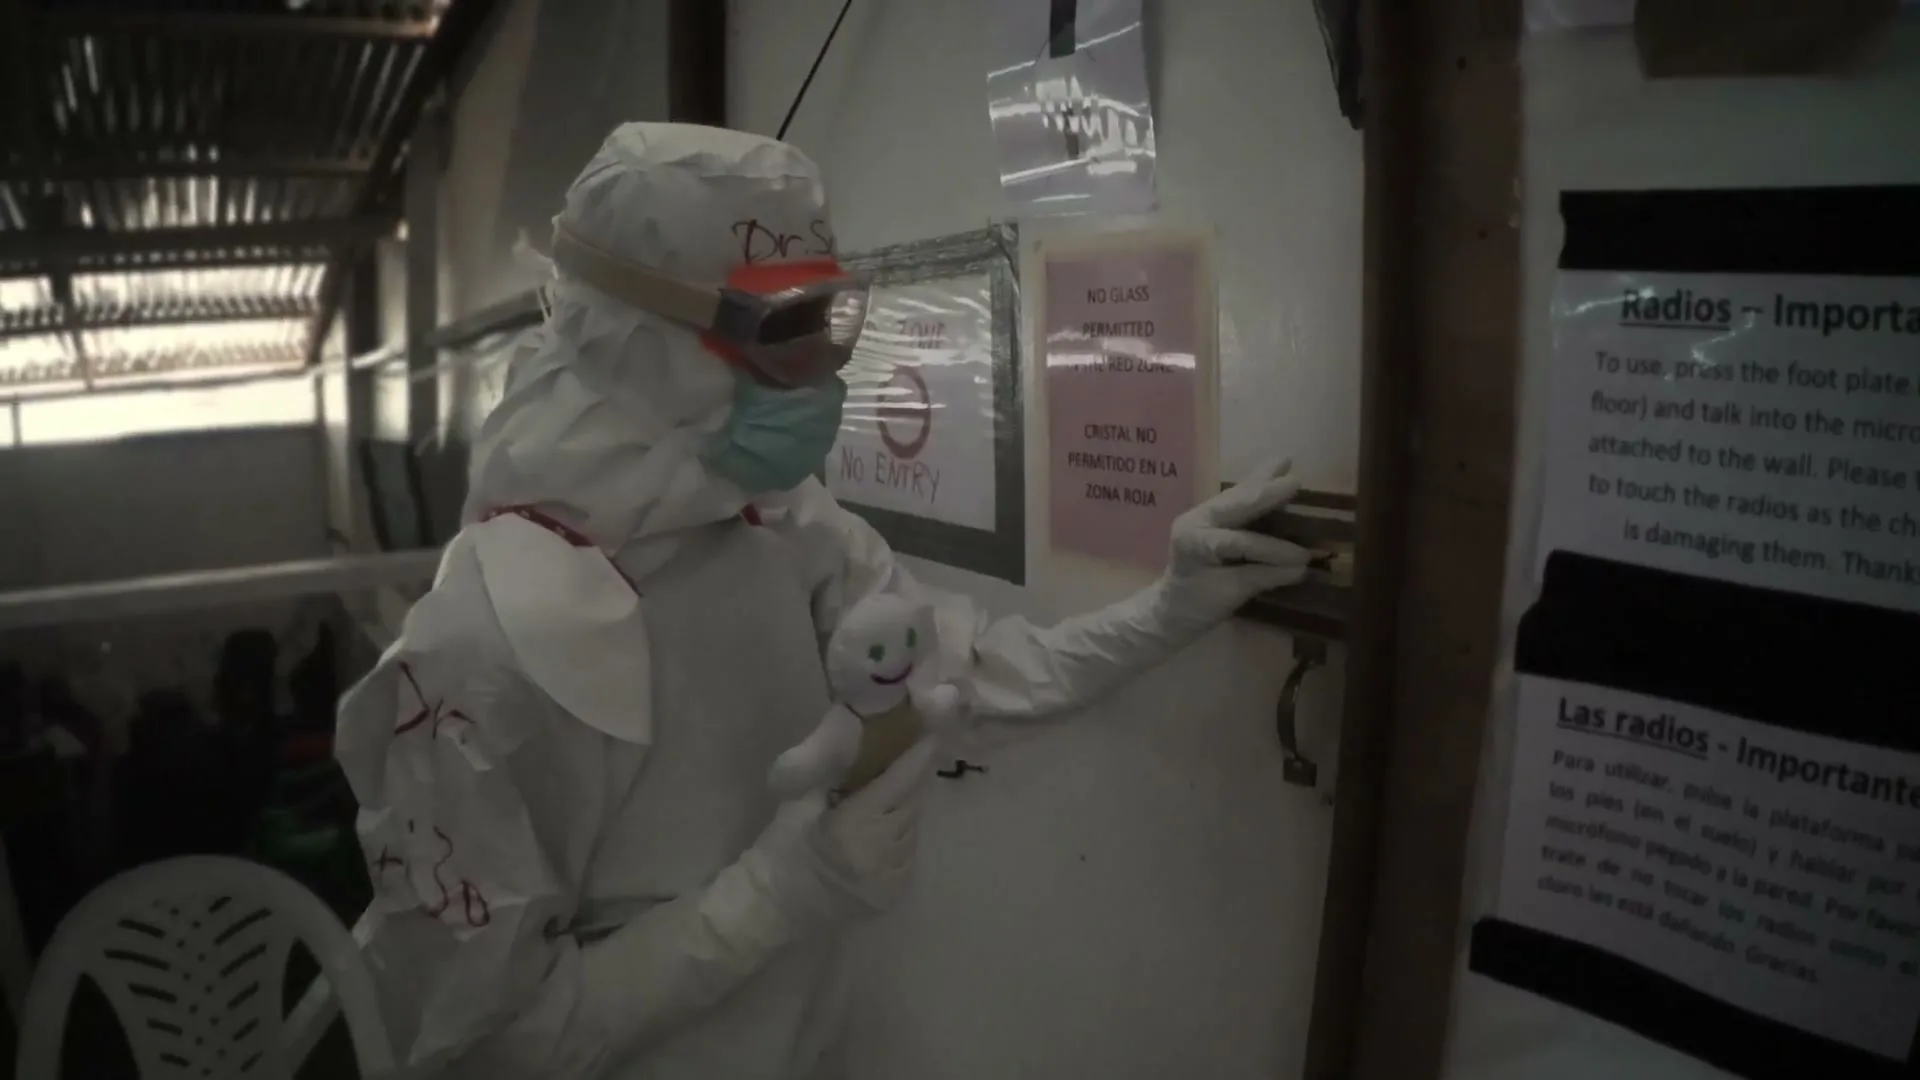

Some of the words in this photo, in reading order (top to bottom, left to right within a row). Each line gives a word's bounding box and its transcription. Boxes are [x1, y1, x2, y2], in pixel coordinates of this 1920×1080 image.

[1087, 287, 1107, 305] NO
[1109, 285, 1151, 303] GLASS
[1620, 287, 1732, 325] Radios
[1082, 320, 1155, 338] PERMITTED
[1595, 350, 1620, 372] To
[1675, 360, 1734, 381] press
[1740, 360, 1780, 385] the
[1787, 360, 1839, 389] foot
[1845, 367, 1911, 395] plate
[1591, 389, 1648, 420] floor)
[1653, 399, 1694, 420] and
[1701, 402, 1741, 425] talk
[1750, 405, 1797, 430] into
[1804, 409, 1845, 435] the
[1084, 423, 1132, 444] CRISTAL
[1136, 426, 1158, 444] NO
[840, 445, 864, 483] NO
[875, 451, 940, 504] ENTRY
[1068, 452, 1135, 474] PERMITIDO
[1139, 454, 1157, 476] EN
[1160, 457, 1178, 478] LA
[1589, 434, 1682, 462] attached
[1688, 443, 1711, 466] to
[1718, 447, 1756, 472] the
[1763, 452, 1818, 478] wall.
[1827, 455, 1907, 490] Please
[1085, 482, 1121, 502] ZONA
[1124, 485, 1157, 507] ROJA
[1589, 473, 1611, 495] to
[1616, 476, 1676, 505] touch
[1683, 484, 1720, 510] the
[1726, 492, 1800, 522] radios
[1807, 503, 1832, 526] as
[1839, 504, 1881, 532] the
[1888, 511, 1920, 538] ch
[1624, 518, 1639, 541] is
[1645, 521, 1756, 564] damaging
[1762, 538, 1832, 570] them.
[1553, 749, 1595, 773] Para
[1558, 696, 1605, 729] Las
[1615, 709, 1710, 754] radios
[1736, 735, 1920, 810] Importante
